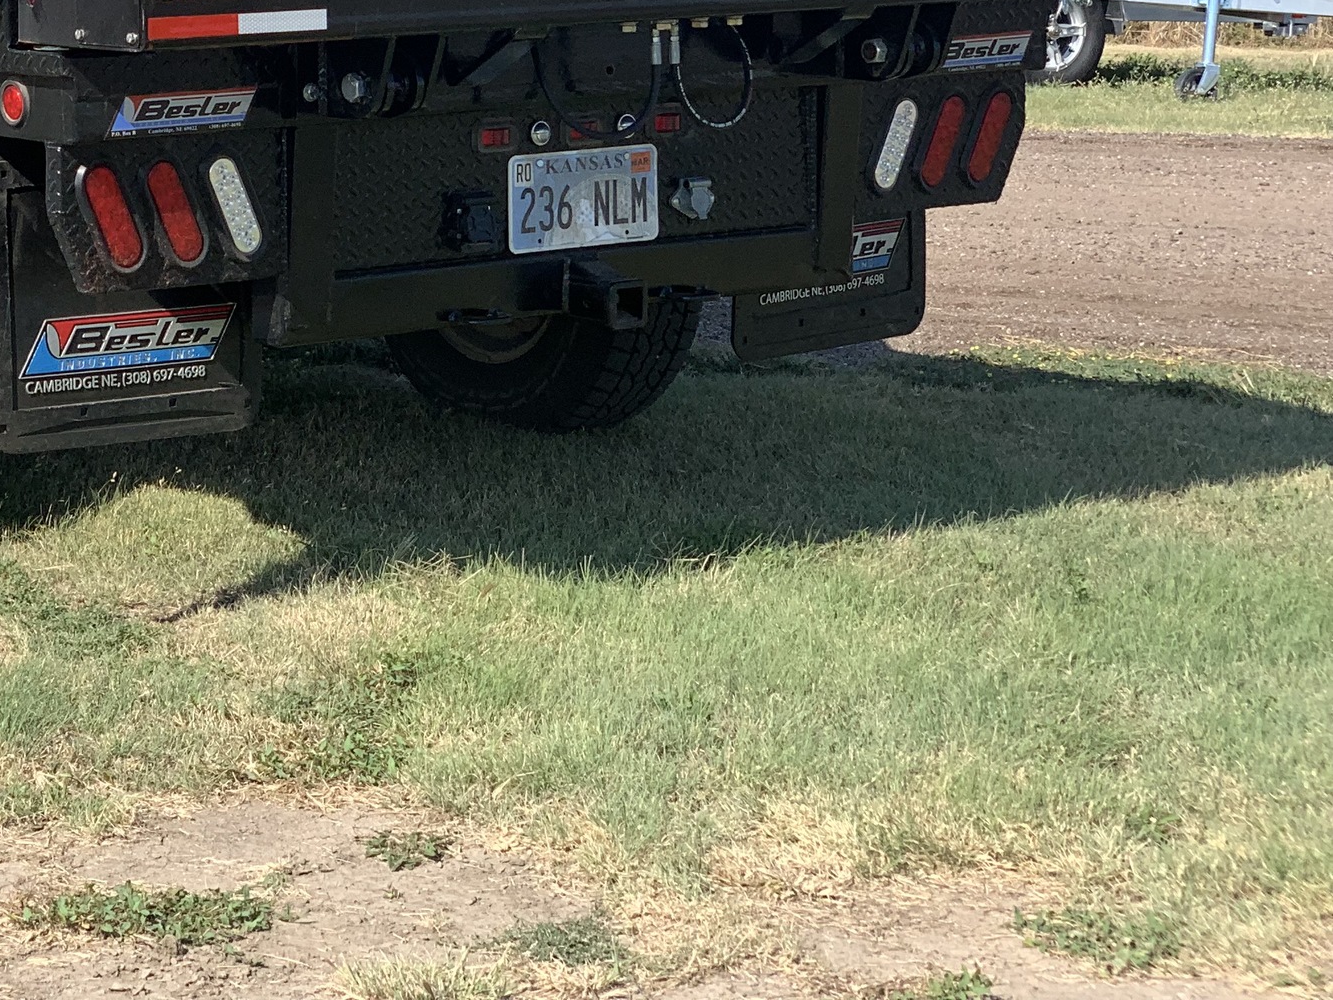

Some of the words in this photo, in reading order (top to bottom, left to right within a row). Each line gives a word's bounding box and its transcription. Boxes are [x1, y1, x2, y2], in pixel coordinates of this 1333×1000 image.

[947, 39, 1020, 59] Besler
[134, 96, 242, 121] Besler
[516, 162, 531, 183] RO
[545, 153, 624, 175] KANSAS
[520, 184, 573, 234] 236
[594, 177, 647, 227] NLM
[759, 288, 810, 305] CAMBRIDGE
[25, 373, 99, 395] CAMBRIDGE
[100, 371, 121, 388] NE,
[122, 369, 151, 387] (308)
[154, 365, 206, 382] 697-4698
